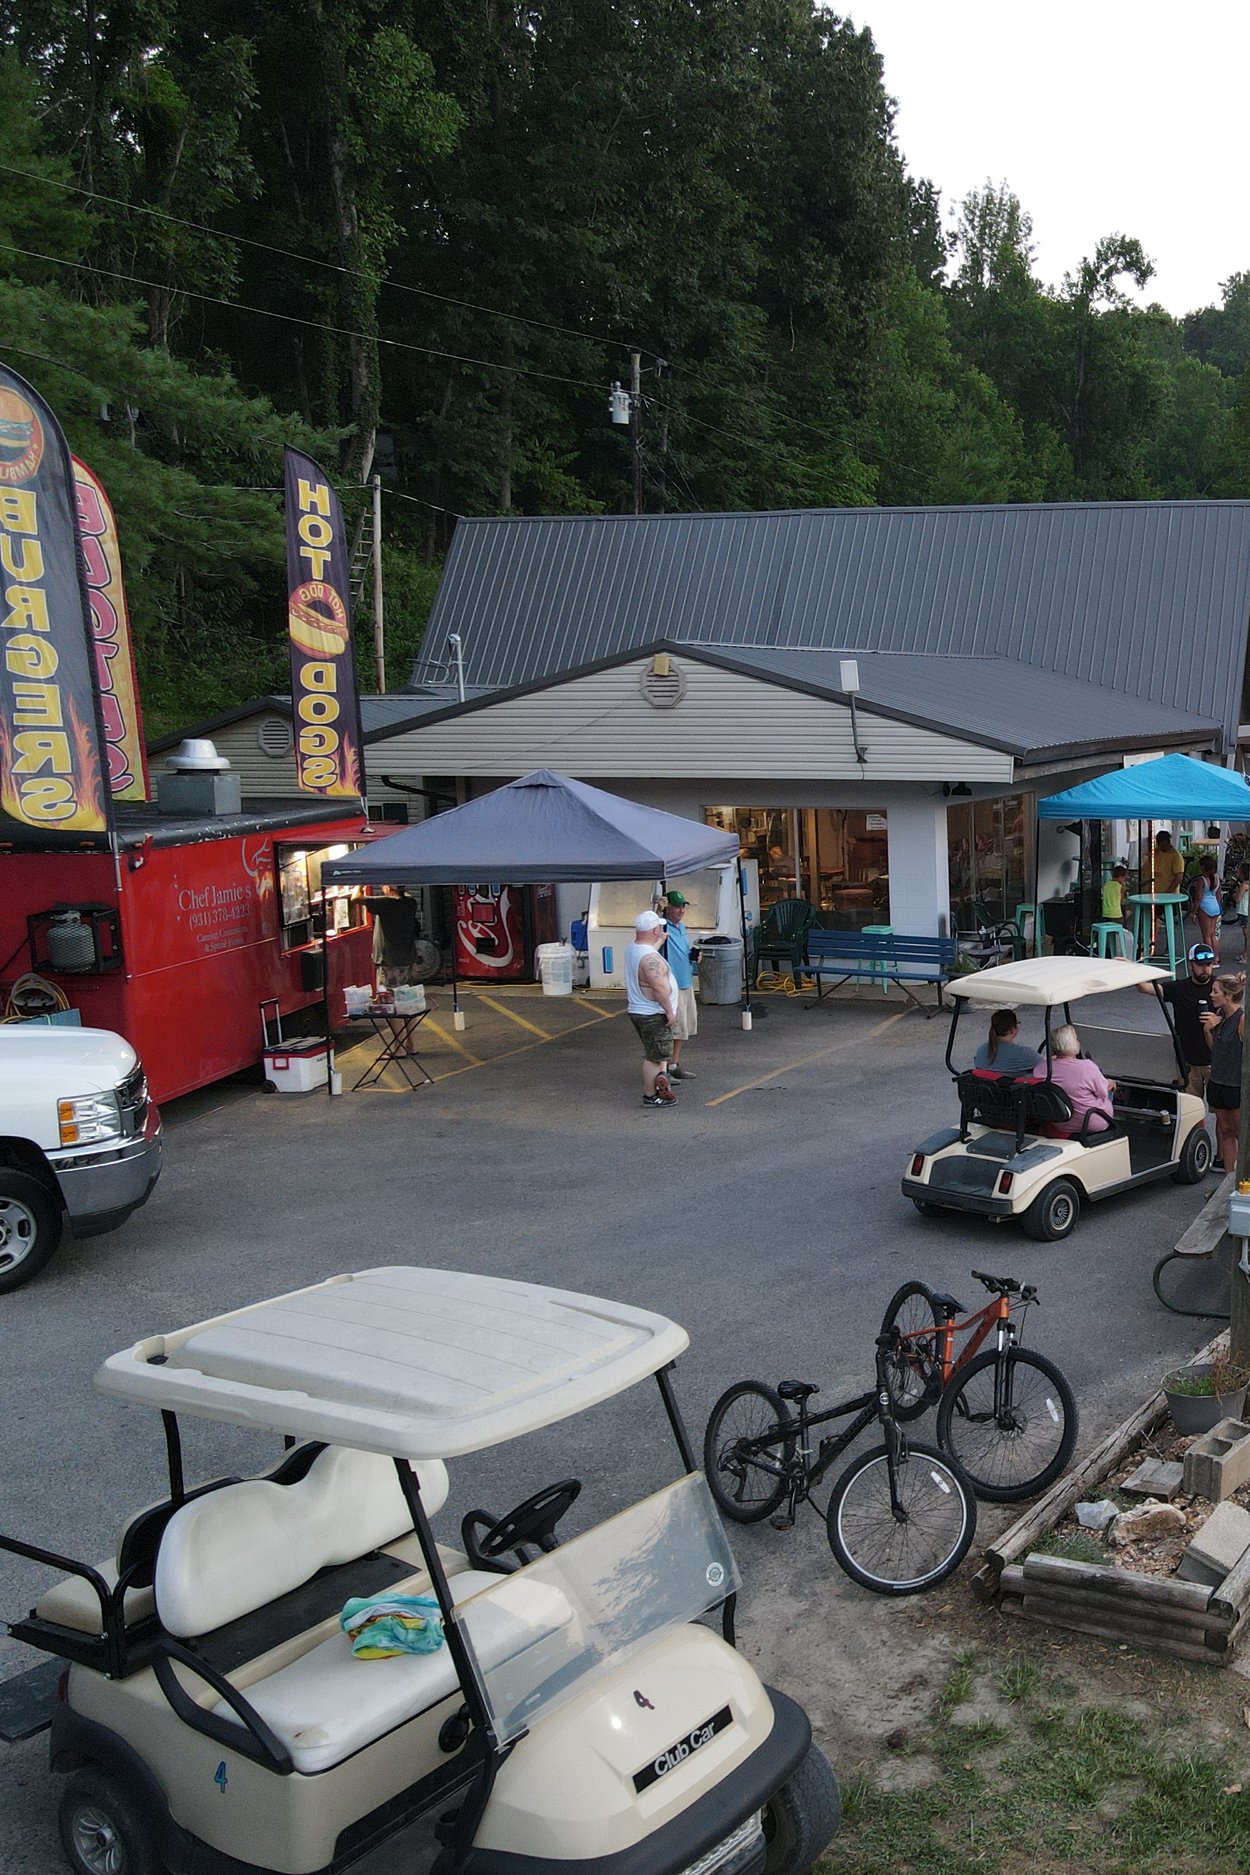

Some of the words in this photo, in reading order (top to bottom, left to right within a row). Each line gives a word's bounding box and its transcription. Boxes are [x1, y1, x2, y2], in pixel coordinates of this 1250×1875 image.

[178, 886, 210, 911] Chef
[211, 883, 251, 907] Jamies
[189, 911, 211, 931] (931)
[633, 1690, 655, 1710] 4
[654, 1743, 690, 1776] Club
[689, 1722, 715, 1749] Car
[214, 1761, 228, 1793] 4
